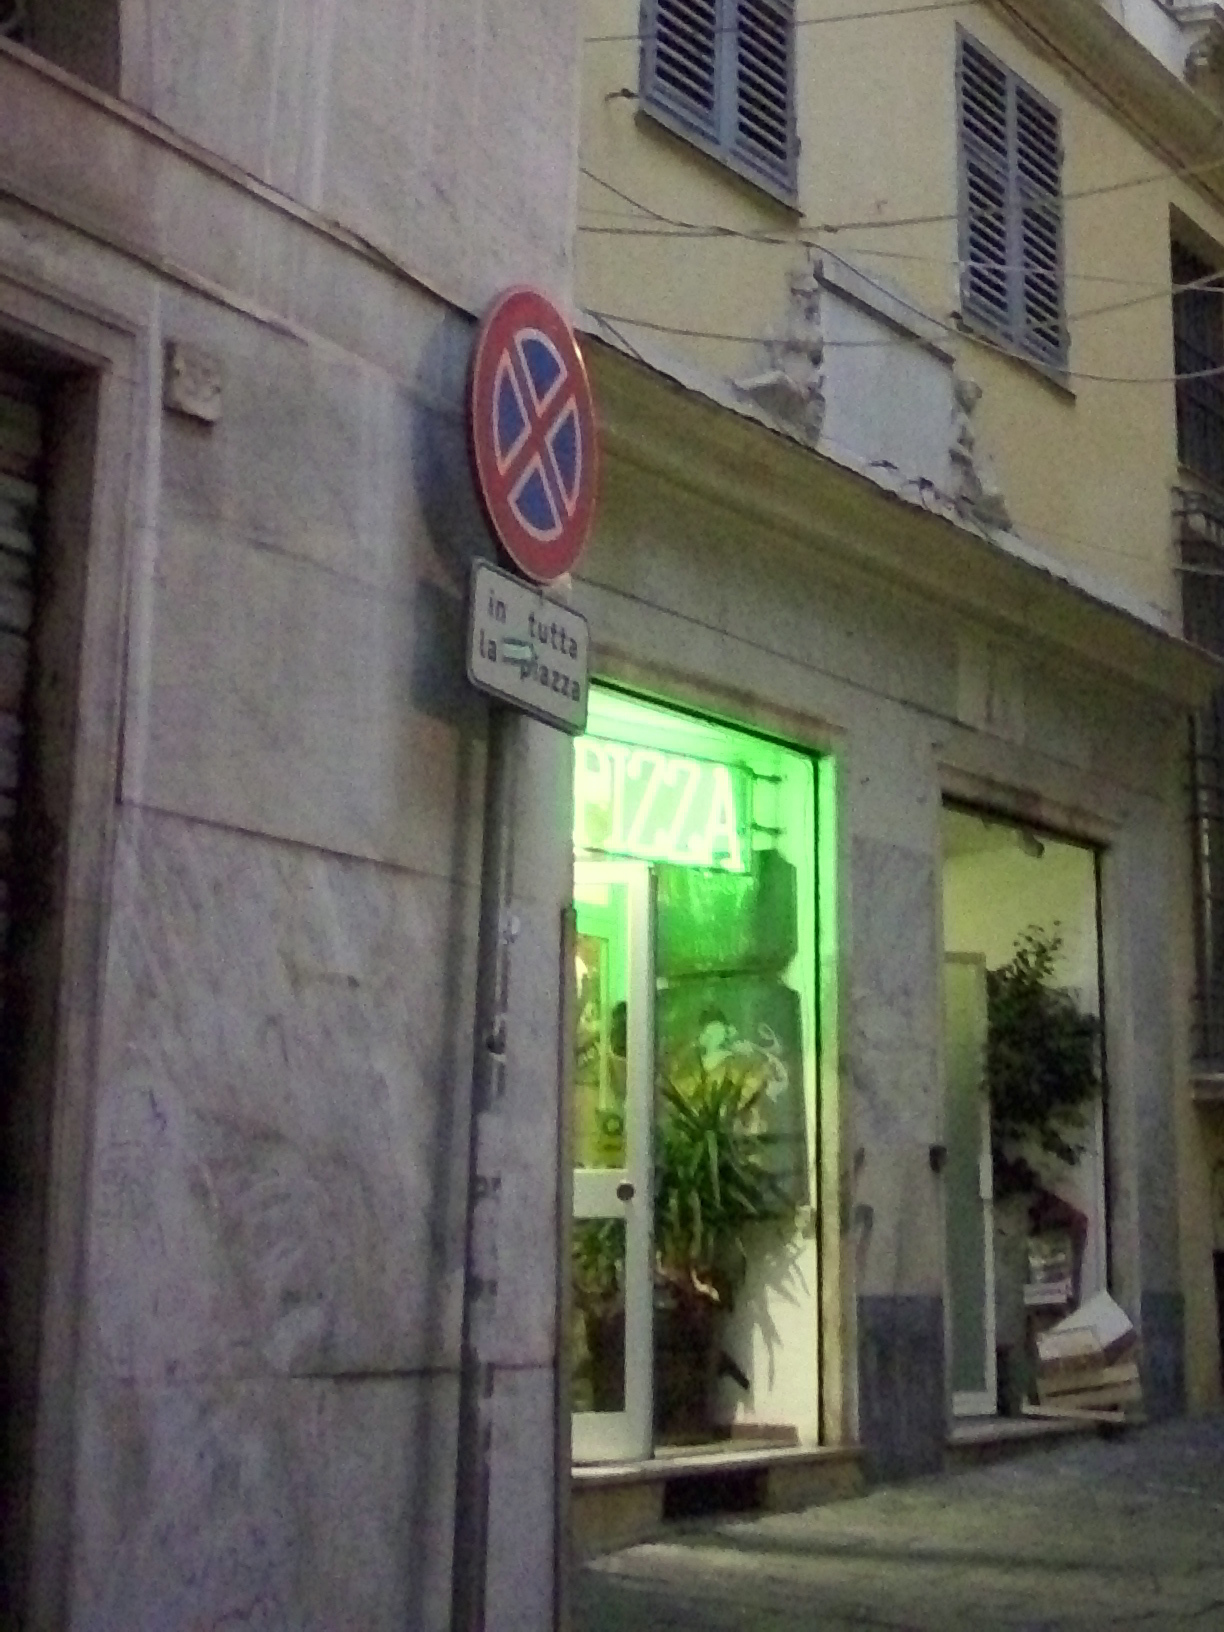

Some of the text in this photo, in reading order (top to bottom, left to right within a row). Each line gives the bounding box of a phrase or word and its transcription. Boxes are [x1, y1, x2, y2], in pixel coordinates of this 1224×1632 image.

[487, 588, 579, 660] in tutta
[479, 627, 582, 703] la piazza
[573, 736, 746, 872] PIZZA
